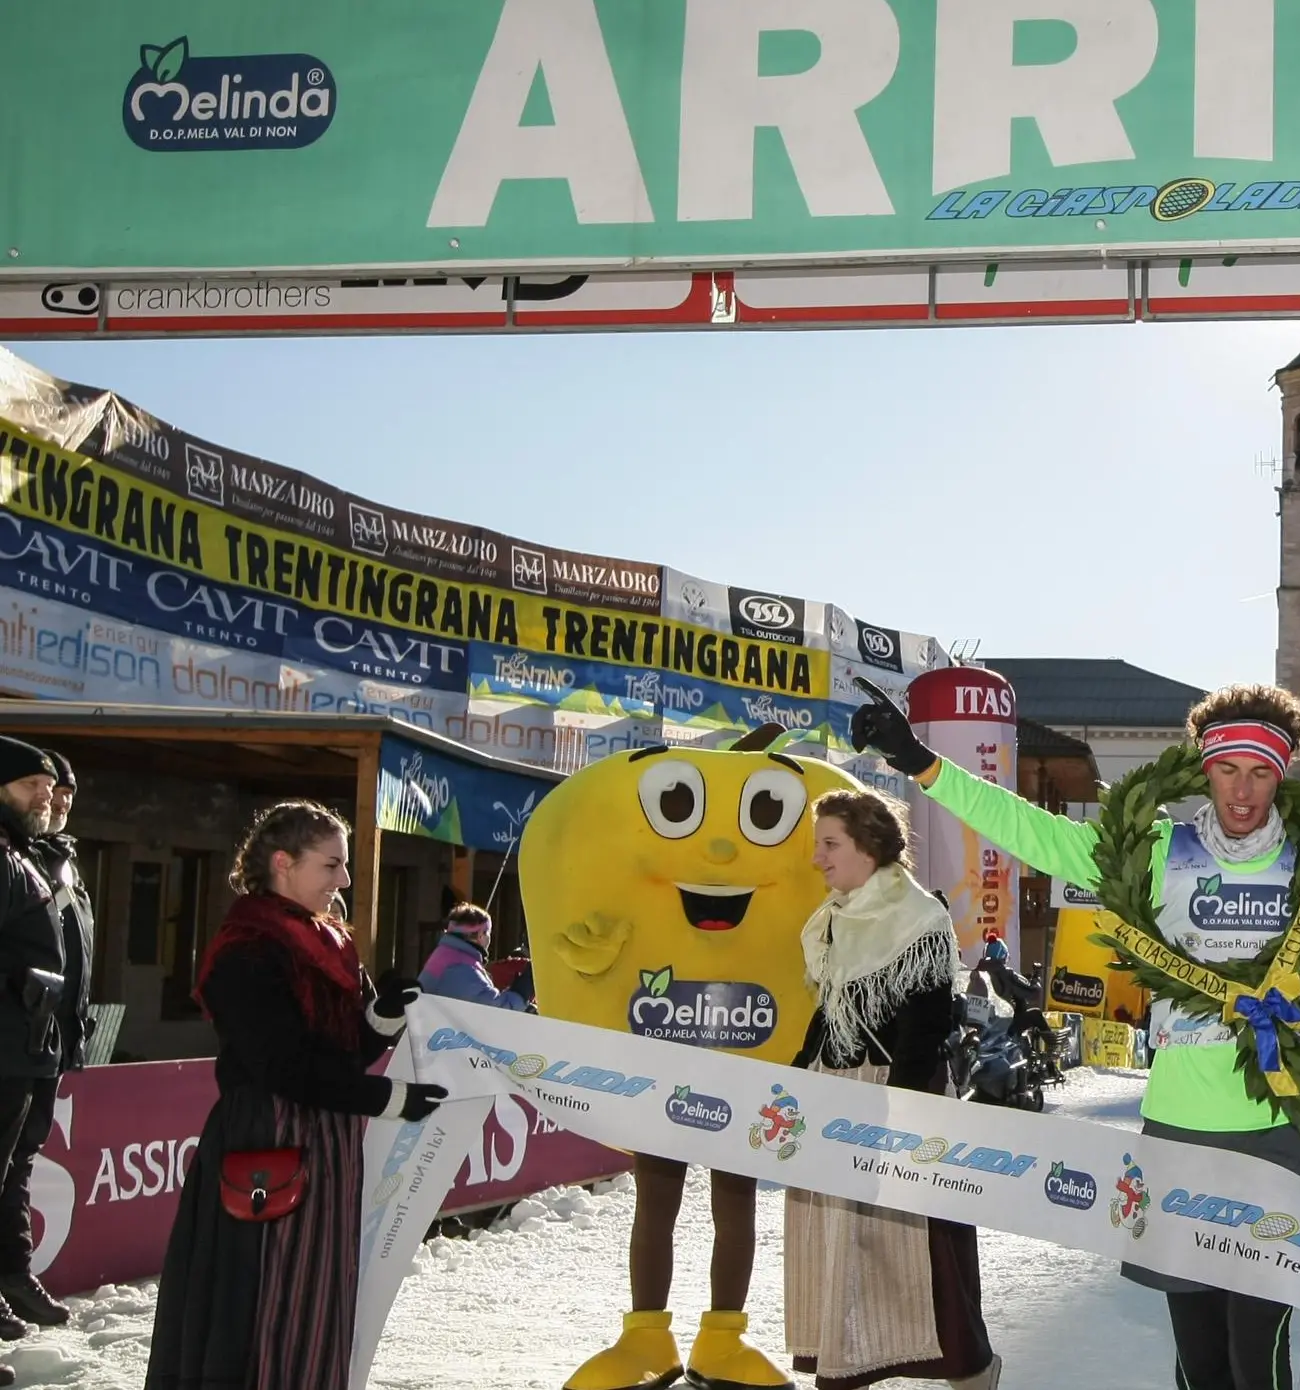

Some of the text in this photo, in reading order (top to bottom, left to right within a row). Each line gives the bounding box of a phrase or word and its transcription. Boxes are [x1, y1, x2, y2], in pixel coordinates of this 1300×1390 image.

[131, 72, 330, 121] Melinda
[224, 127, 246, 138] VAL
[250, 126, 262, 137] DI
[266, 126, 297, 137] NON
[925, 190, 1011, 220] LA
[116, 281, 331, 309] crankbrothers
[230, 463, 335, 520] MARZADRO
[0, 513, 134, 592] CAVIT
[391, 518, 498, 564] MARZADRO
[17, 570, 91, 603] TRENTO
[224, 523, 518, 647] TRENTINGRANA
[552, 558, 660, 594] MARZADRO
[146, 570, 298, 637] CAVIT
[184, 621, 258, 648] TRENTO
[313, 616, 465, 674] CAVIT
[543, 606, 811, 695] TRENTINGRANA
[350, 661, 422, 685] TRENTO
[955, 685, 1012, 717] ITAS
[1204, 938, 1235, 950] Casse
[1134, 936, 1228, 1000] CIASPOLADA
[632, 993, 774, 1028] Melinda
[700, 1030, 717, 1040] VAL
[719, 1031, 730, 1041] DI
[731, 1031, 756, 1041] NON
[534, 1086, 591, 1113] Trentino
[669, 1098, 729, 1124] Melinda
[852, 1155, 873, 1173] Val
[875, 1161, 888, 1176] di
[892, 1163, 920, 1183] Non
[930, 1172, 984, 1196] Trentino
[1047, 1176, 1095, 1200] Melinda
[1194, 1231, 1215, 1250] Val
[1218, 1233, 1232, 1253] di
[1234, 1240, 1261, 1262] Non
